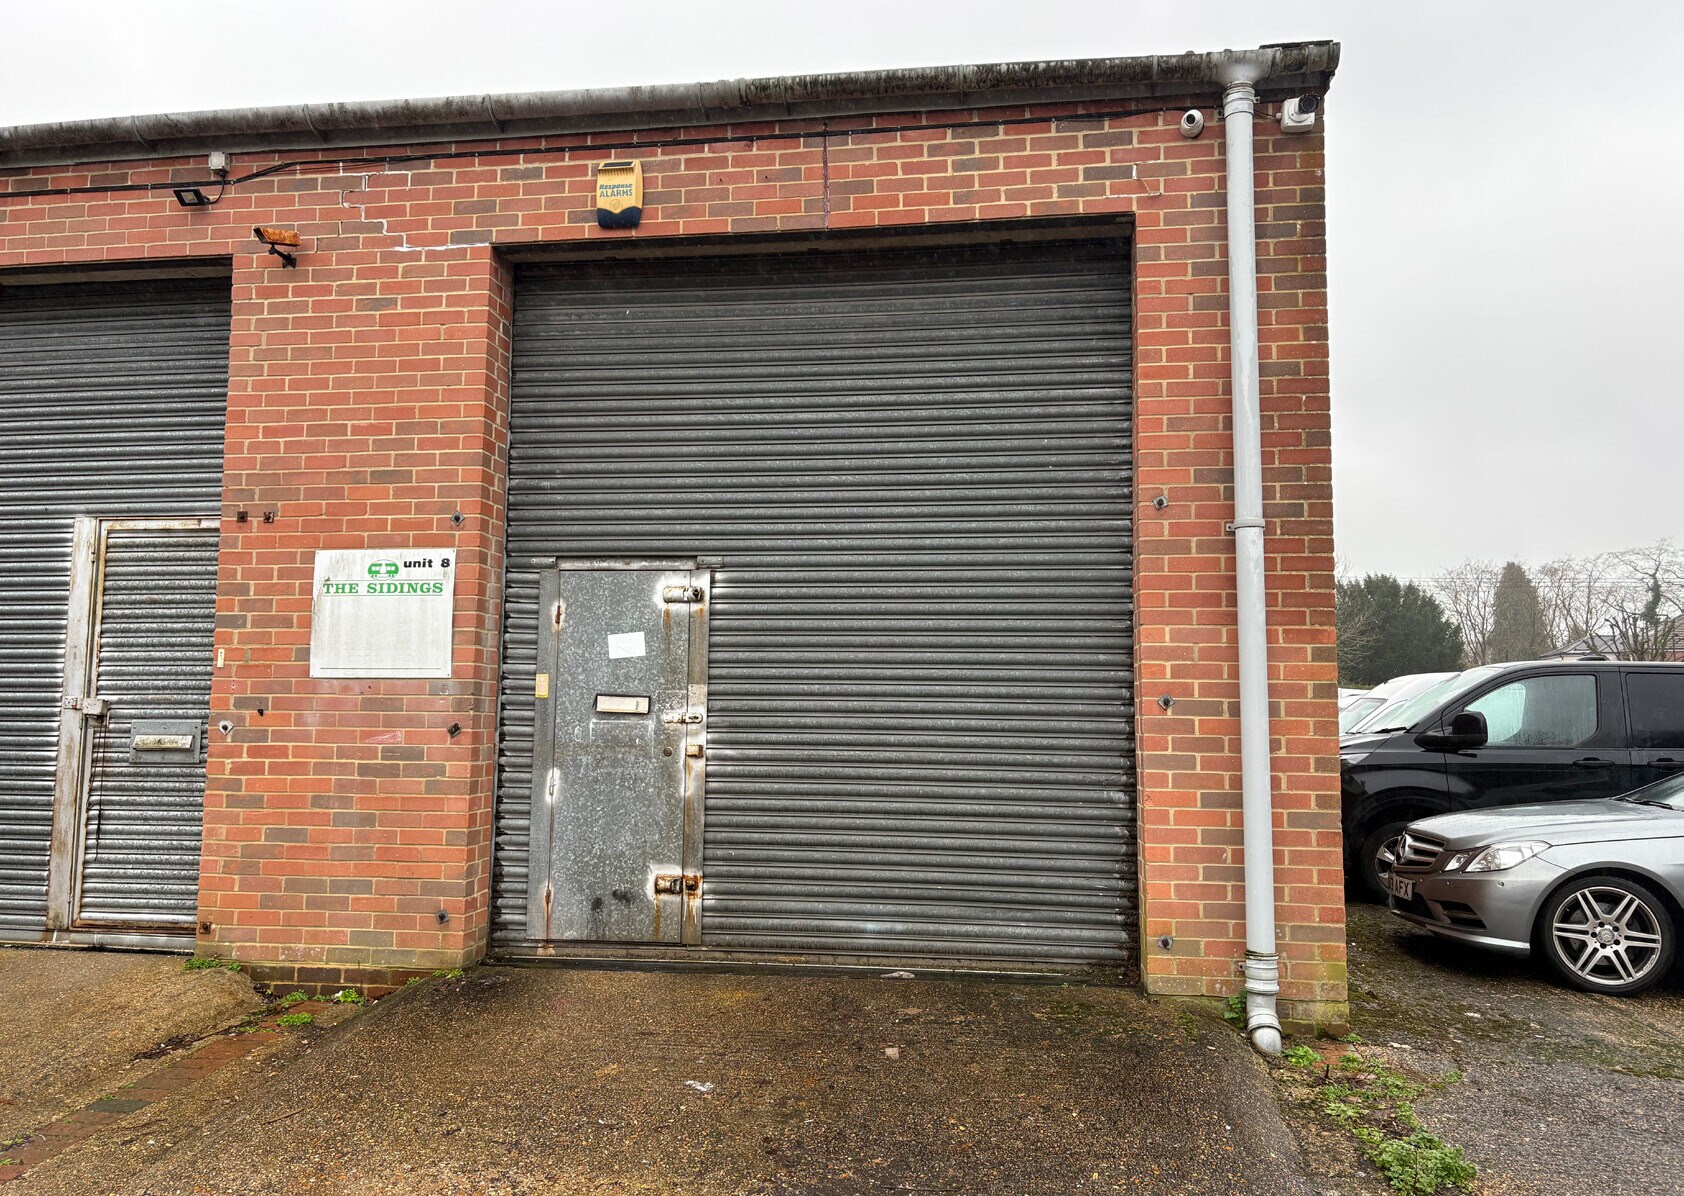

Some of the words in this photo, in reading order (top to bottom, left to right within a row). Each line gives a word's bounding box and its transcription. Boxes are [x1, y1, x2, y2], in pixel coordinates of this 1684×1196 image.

[599, 189, 633, 198] ALARMS
[403, 558, 433, 568] unit
[440, 558, 451, 568] 8
[322, 583, 359, 594] THE
[366, 582, 444, 594] SIDINGS
